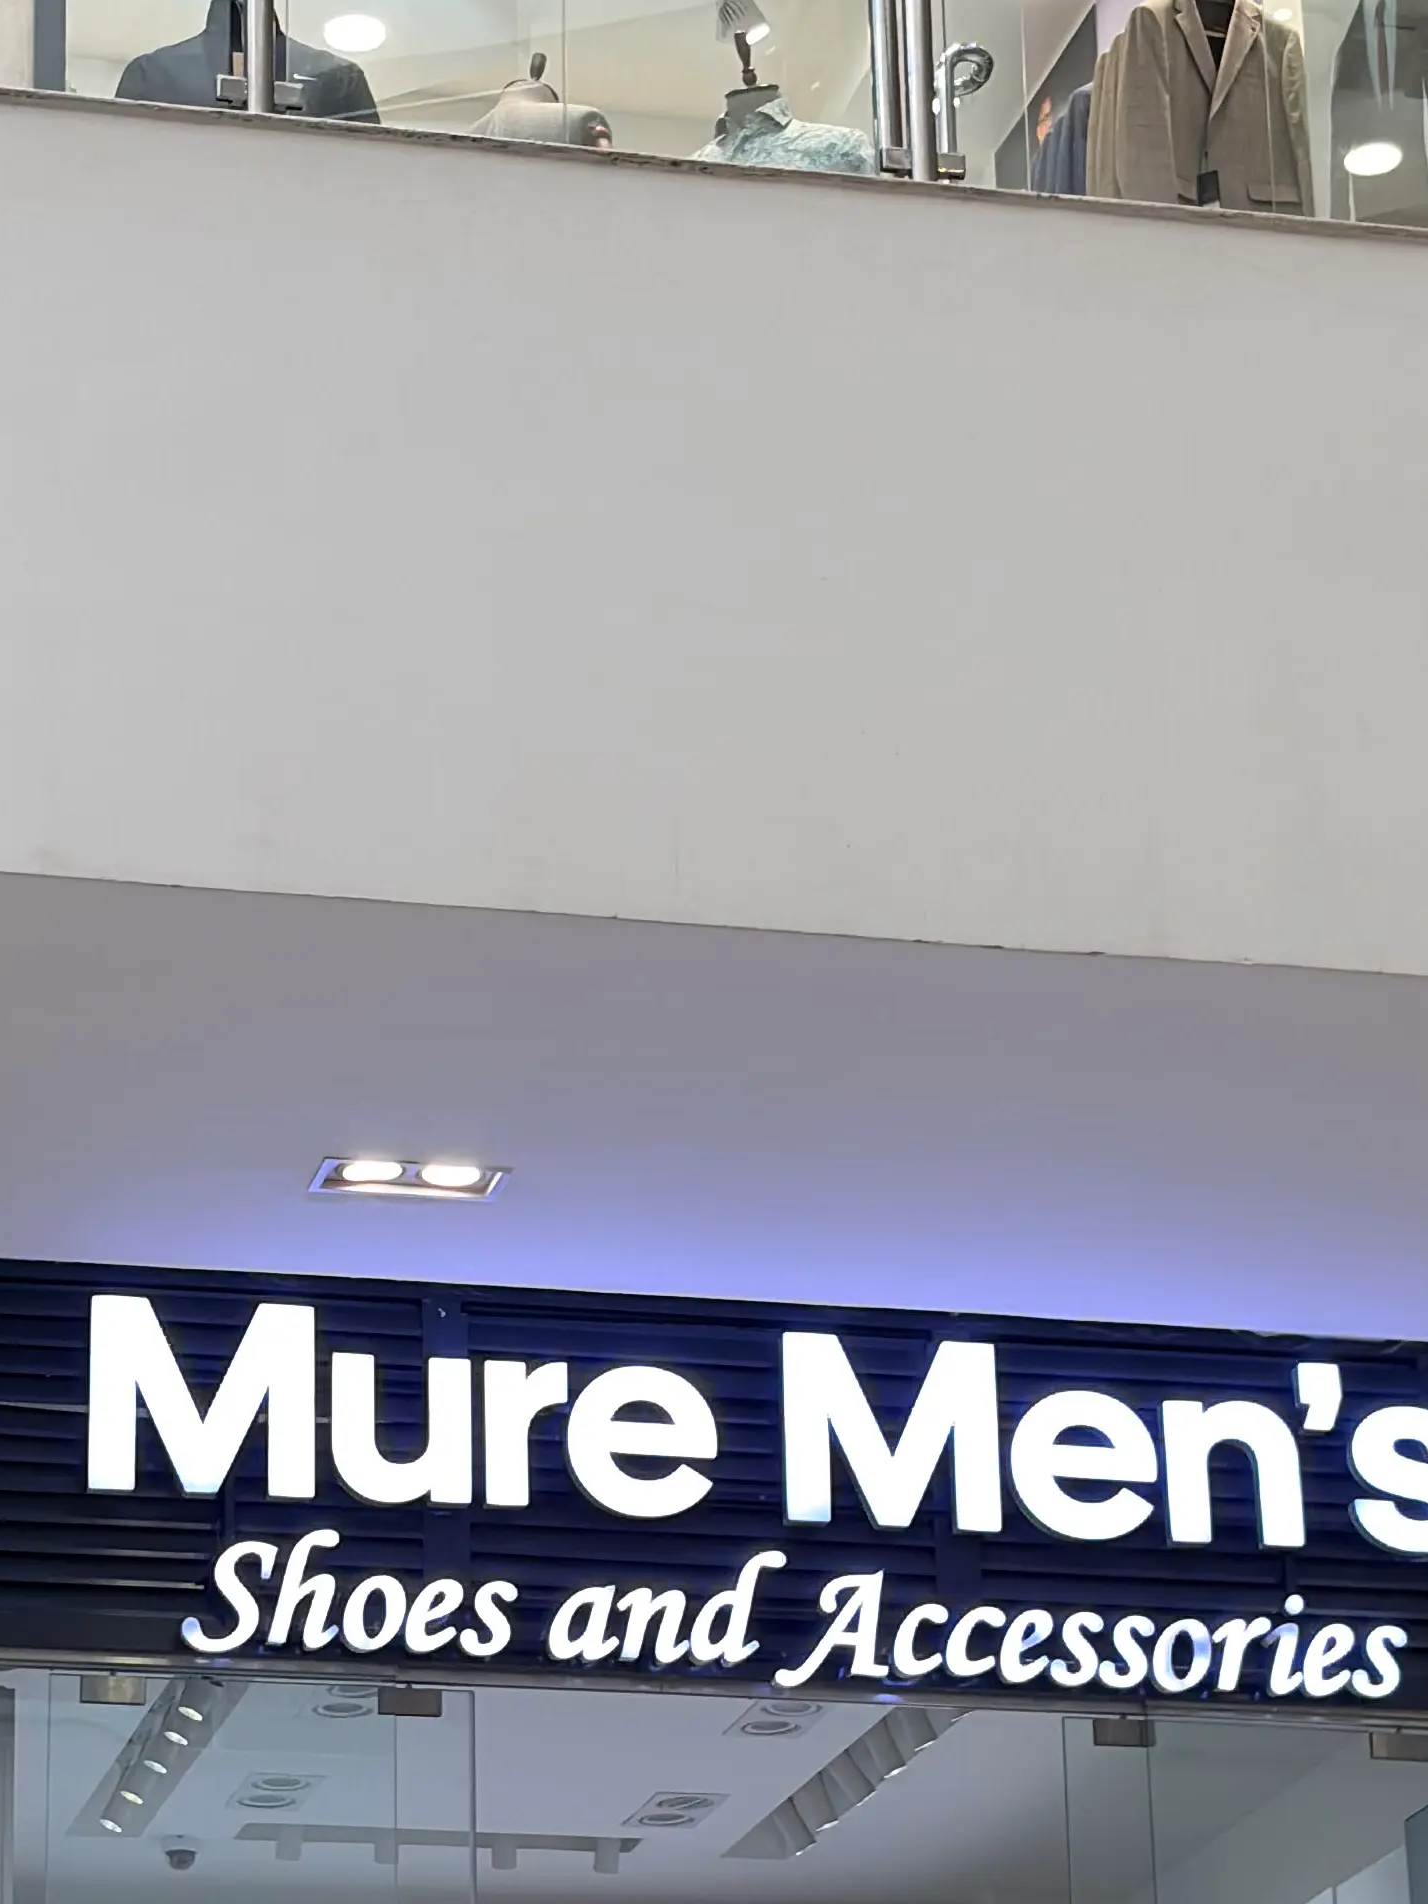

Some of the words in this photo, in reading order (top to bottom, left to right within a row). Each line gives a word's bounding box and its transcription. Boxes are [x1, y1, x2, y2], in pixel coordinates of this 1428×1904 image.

[86, 1294, 719, 1518] Mure
[181, 1529, 518, 1660] Shoes
[548, 1549, 787, 1667] and
[775, 1568, 1409, 1698] Accessories
